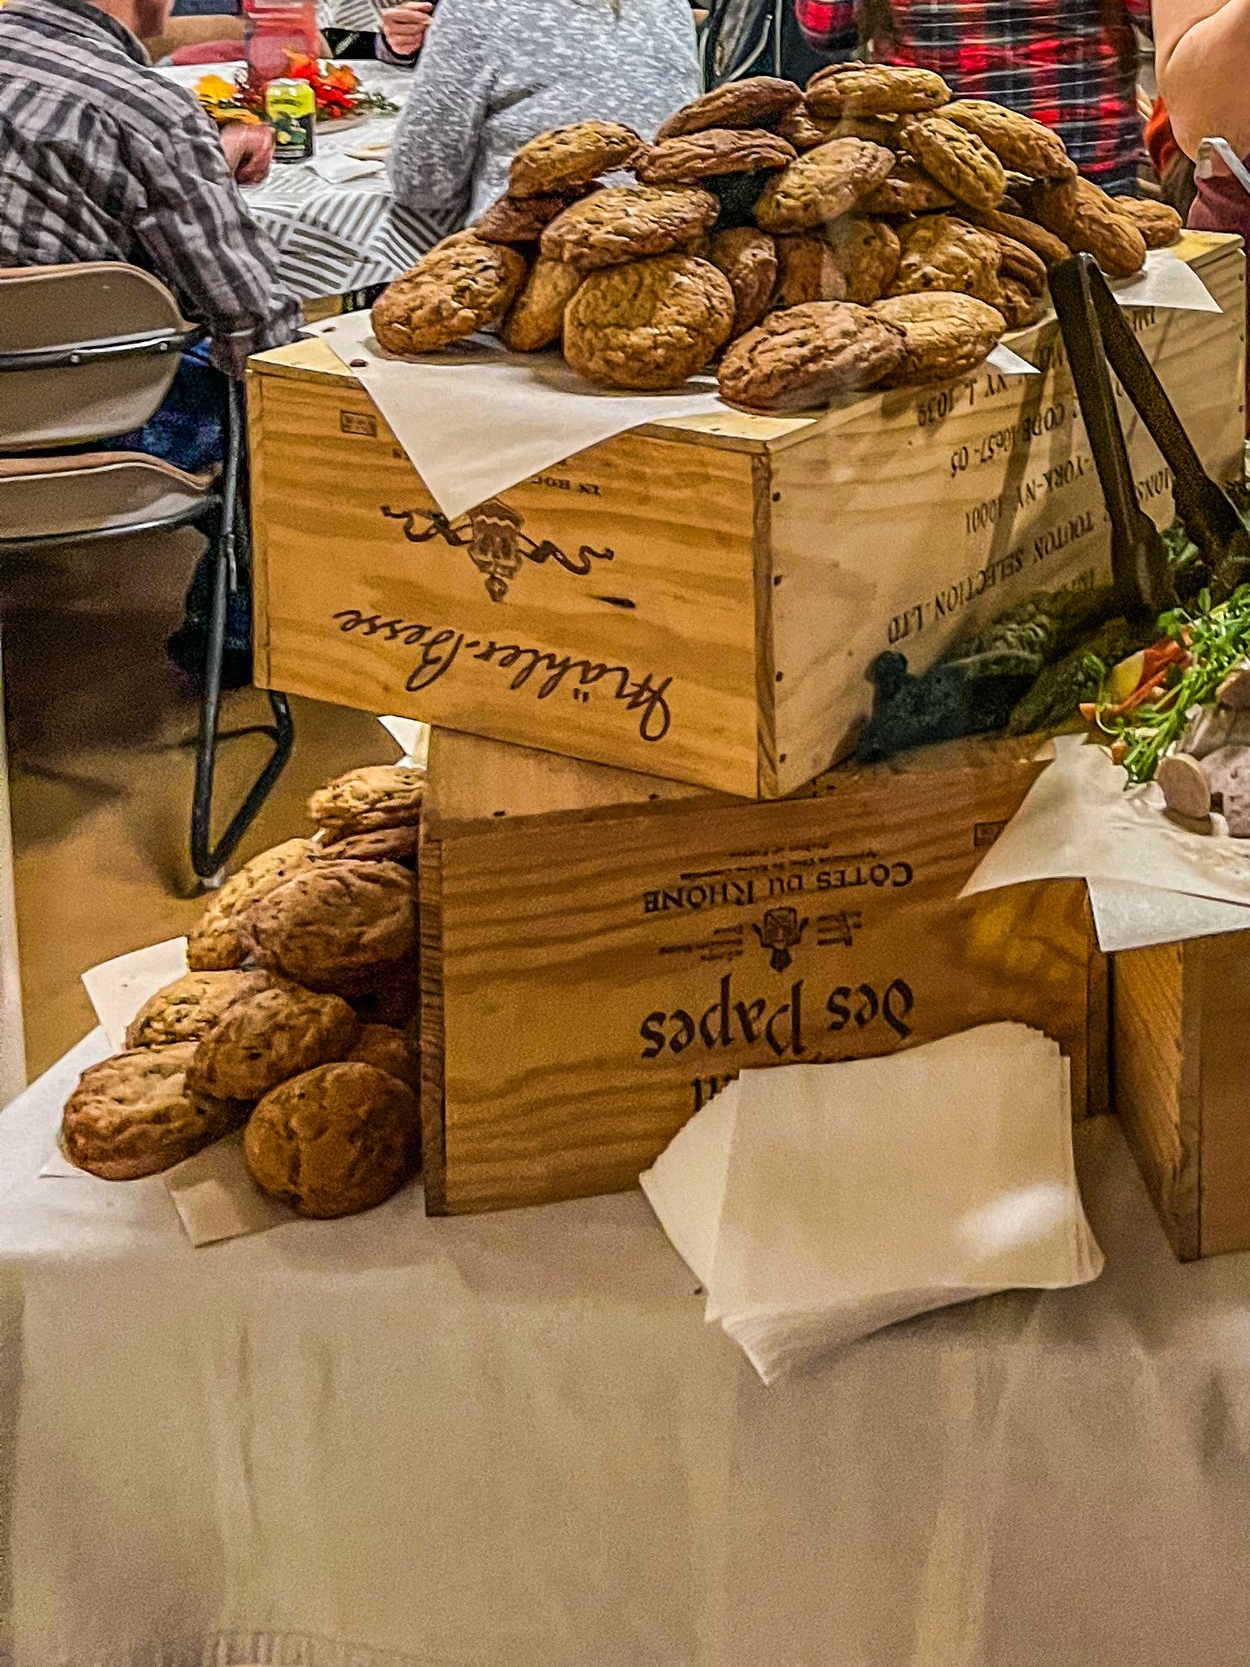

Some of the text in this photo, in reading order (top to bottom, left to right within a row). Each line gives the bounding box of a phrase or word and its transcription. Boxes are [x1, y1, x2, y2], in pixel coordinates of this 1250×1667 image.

[1031, 511, 1095, 566] TOUTON
[638, 973, 915, 1061] des Papes
